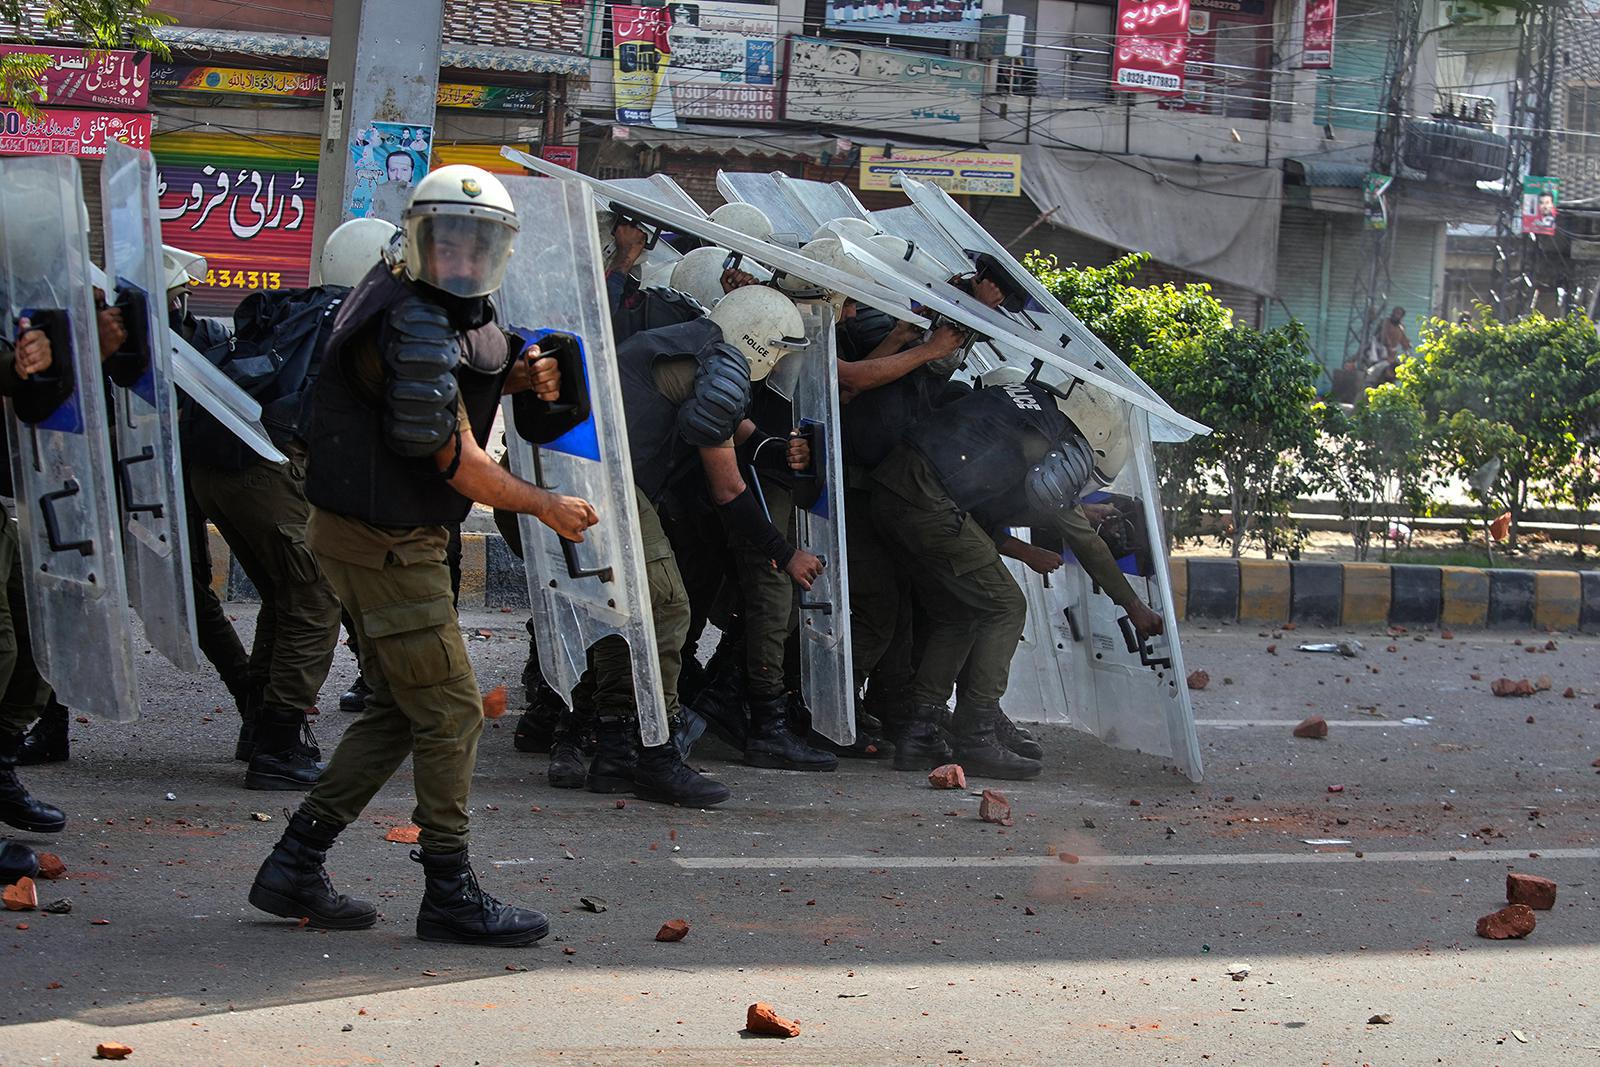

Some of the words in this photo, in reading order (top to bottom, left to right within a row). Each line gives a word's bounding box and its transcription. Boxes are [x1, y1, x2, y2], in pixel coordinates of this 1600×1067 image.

[86, 54, 119, 92] قلفی
[119, 55, 145, 98] بابا
[676, 84, 774, 102] 0301-4178014
[675, 101, 774, 120] 0321-8634316
[81, 116, 109, 145] قلفی
[131, 124, 146, 145] بابا
[229, 169, 305, 239] ڈرائی
[742, 334, 770, 358] POLICE
[1003, 382, 1042, 411] OLICE
